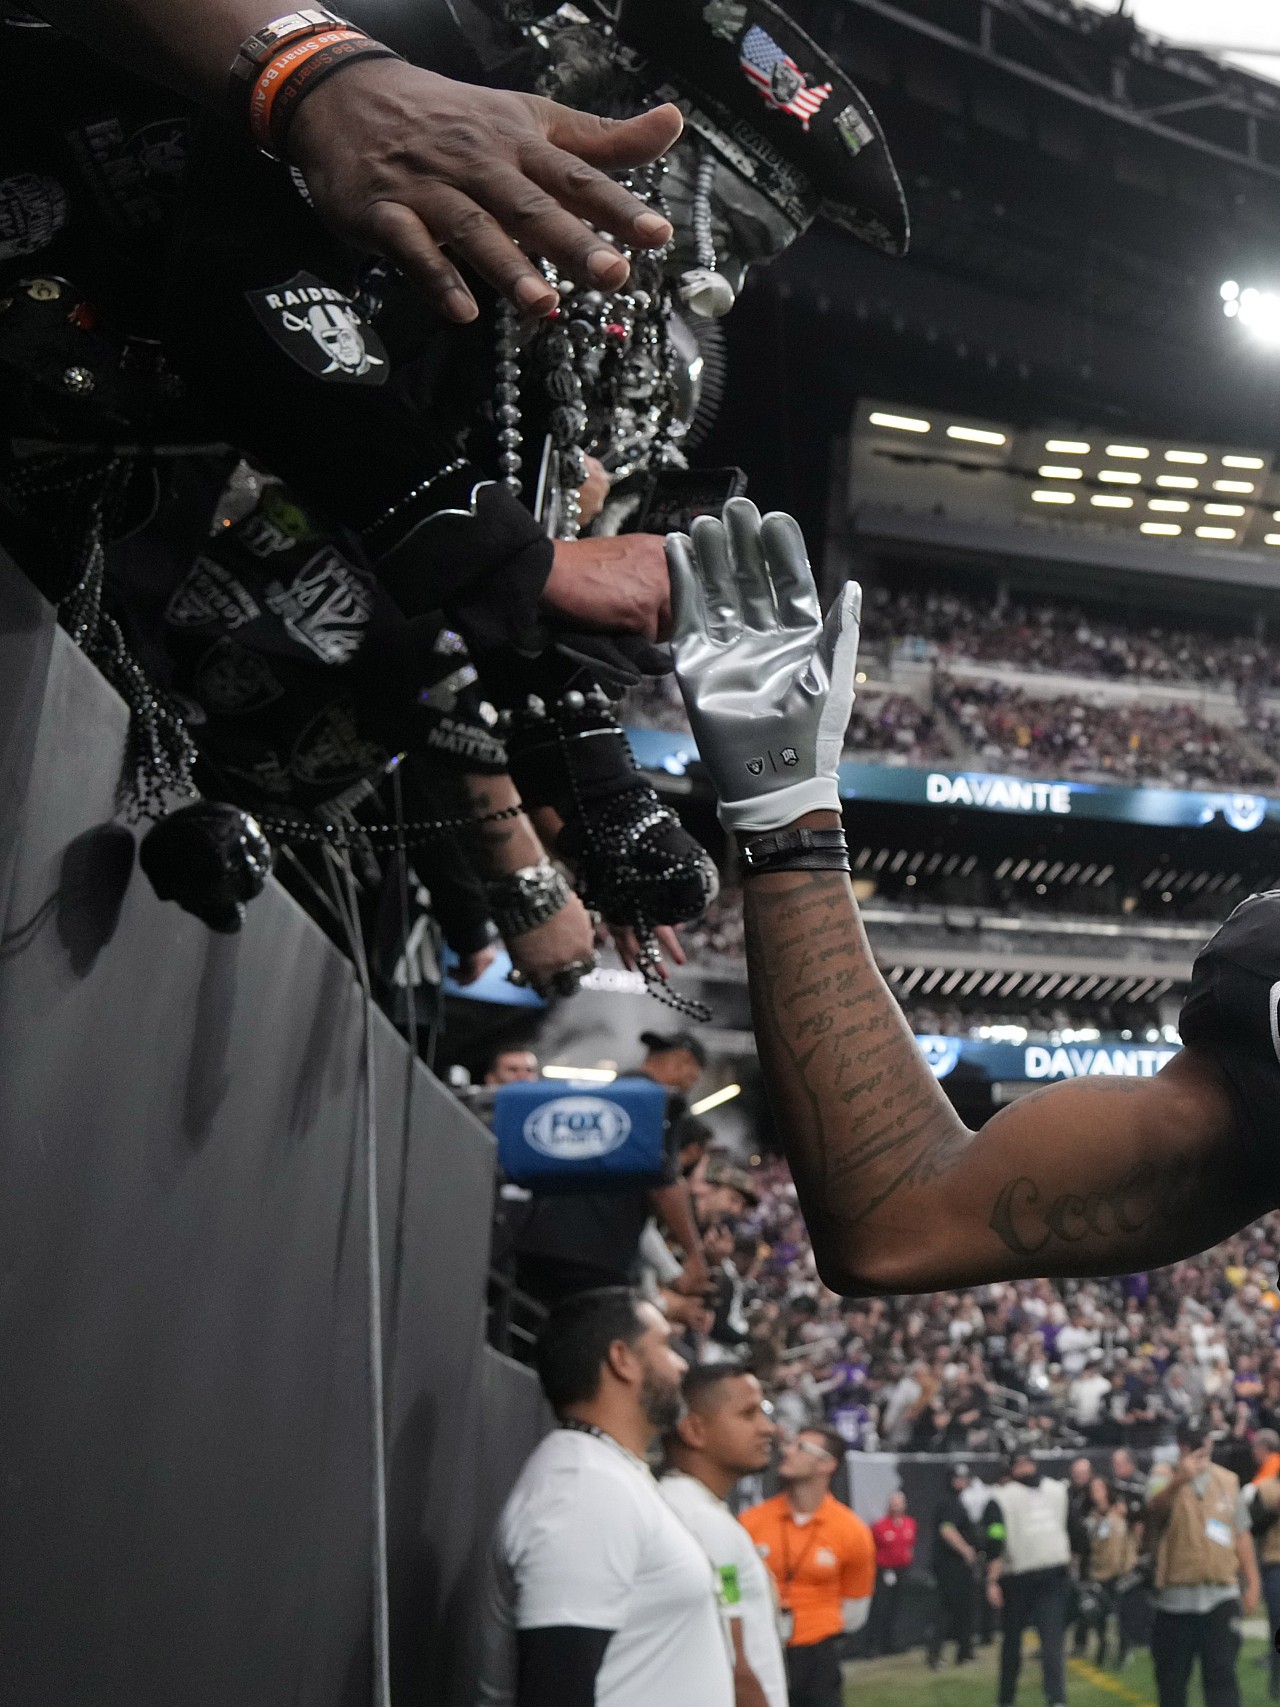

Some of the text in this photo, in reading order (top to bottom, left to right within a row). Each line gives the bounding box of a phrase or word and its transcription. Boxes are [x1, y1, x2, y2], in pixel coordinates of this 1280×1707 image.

[275, 41, 319, 69] Smart
[262, 69, 279, 87] Be
[265, 287, 353, 310] RAIDER
[927, 776, 1071, 814] DAVANTE
[551, 1113, 601, 1130] FOX
